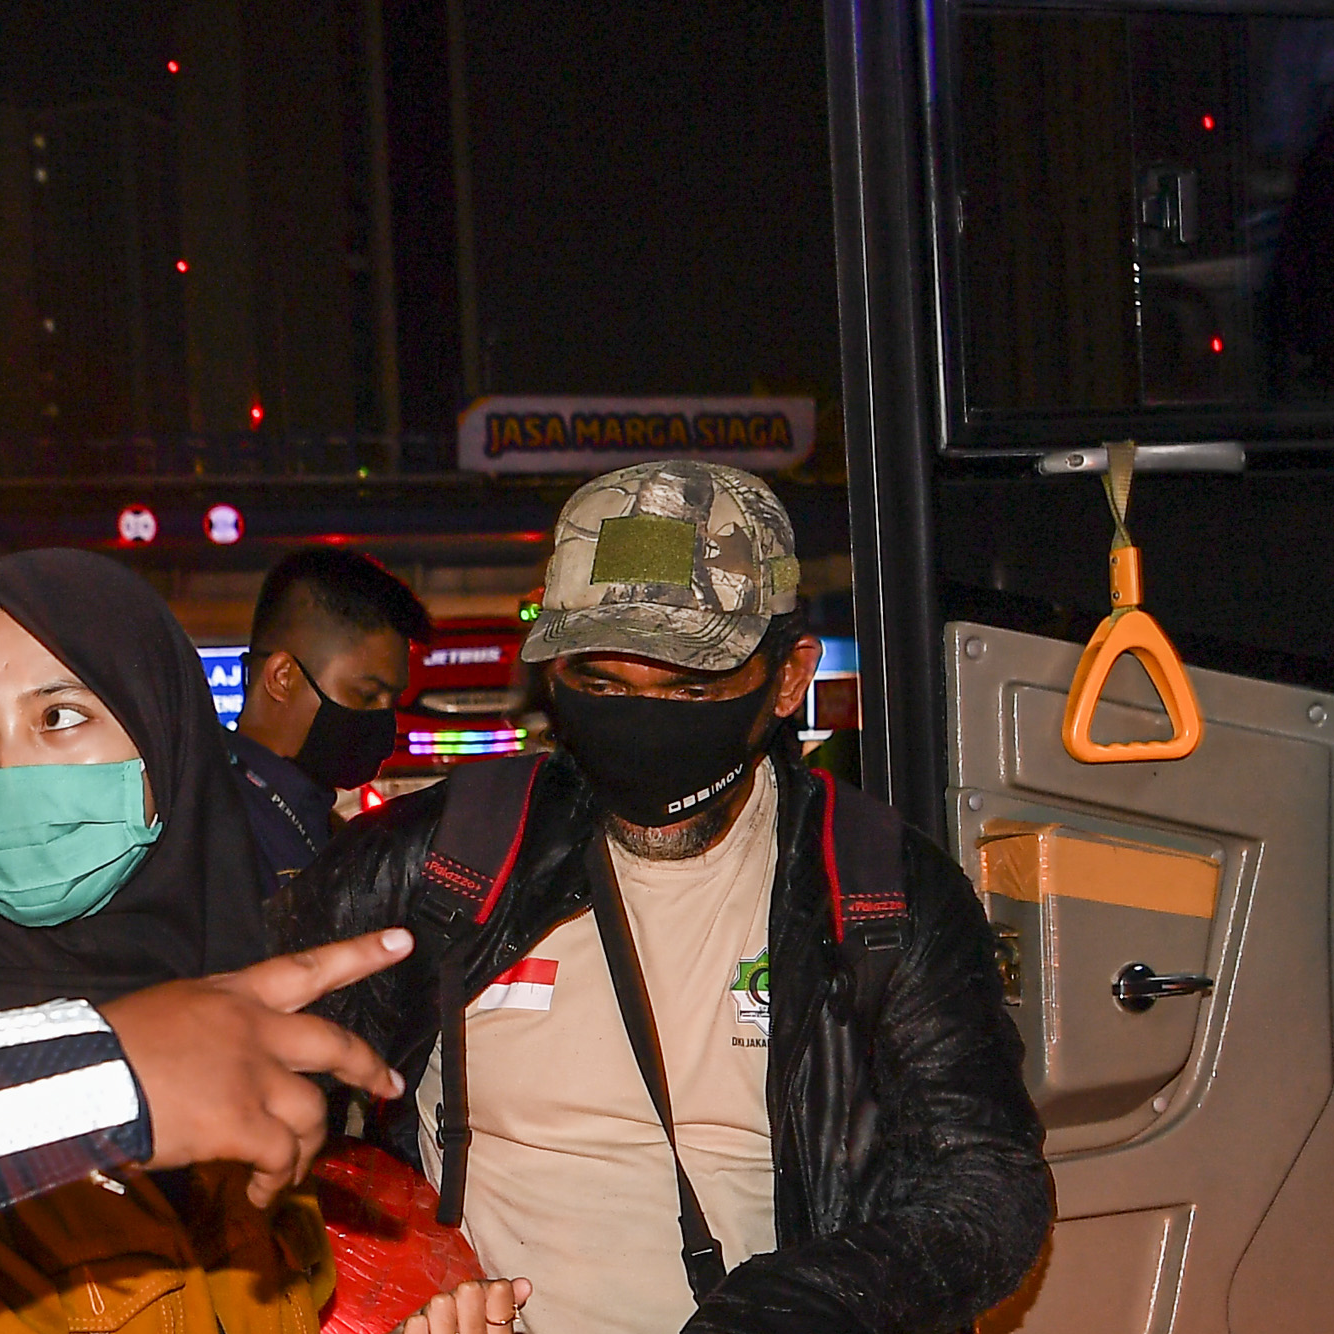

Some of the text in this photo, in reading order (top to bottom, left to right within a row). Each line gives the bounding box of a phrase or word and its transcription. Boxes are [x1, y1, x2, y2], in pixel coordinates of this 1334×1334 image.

[487, 413, 793, 456] JASA MARGA SIAGA
[746, 1038, 771, 1048] JAKA
